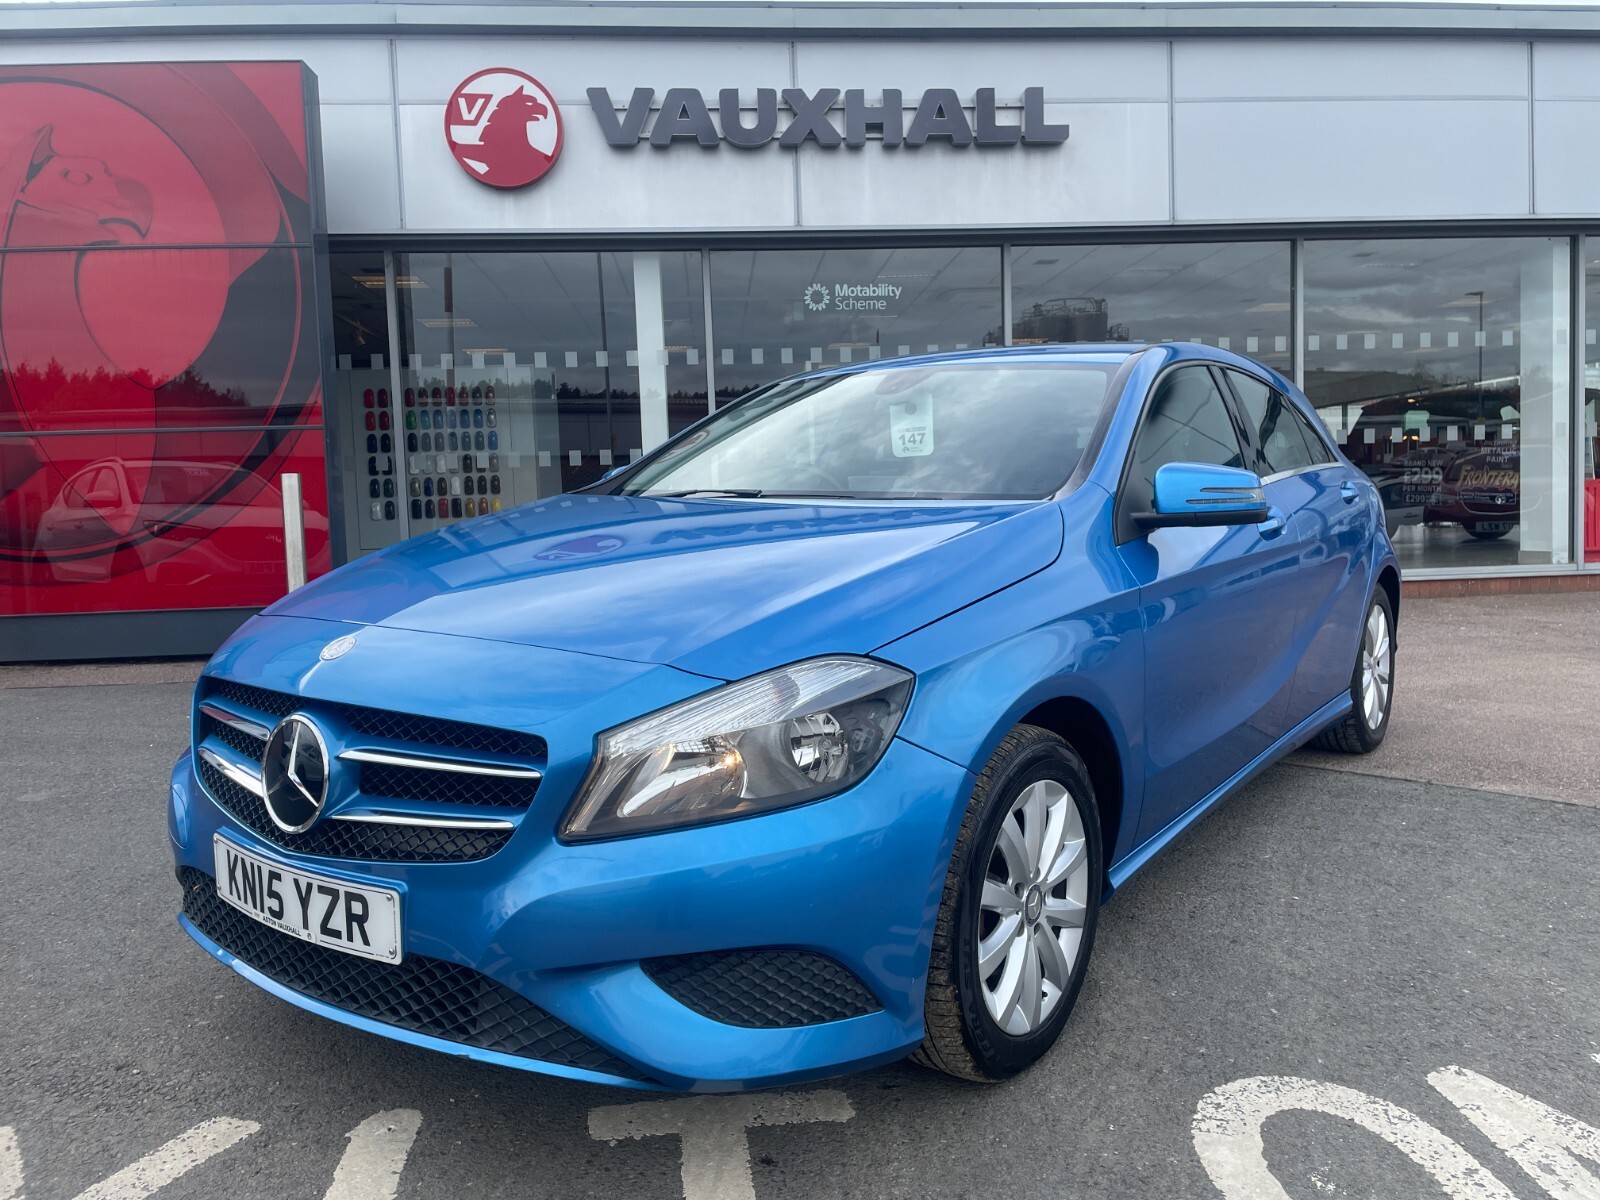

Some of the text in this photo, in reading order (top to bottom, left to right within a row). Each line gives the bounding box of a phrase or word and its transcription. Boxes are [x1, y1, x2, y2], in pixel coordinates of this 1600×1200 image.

[586, 87, 1070, 149] VAUXHALL
[835, 284, 902, 300] Motability
[835, 298, 887, 310] Scheme
[898, 432, 926, 446] 147
[1404, 467, 1443, 484] £299
[226, 849, 371, 947] KN15 YZR
[277, 921, 302, 937] VAUXHALL
